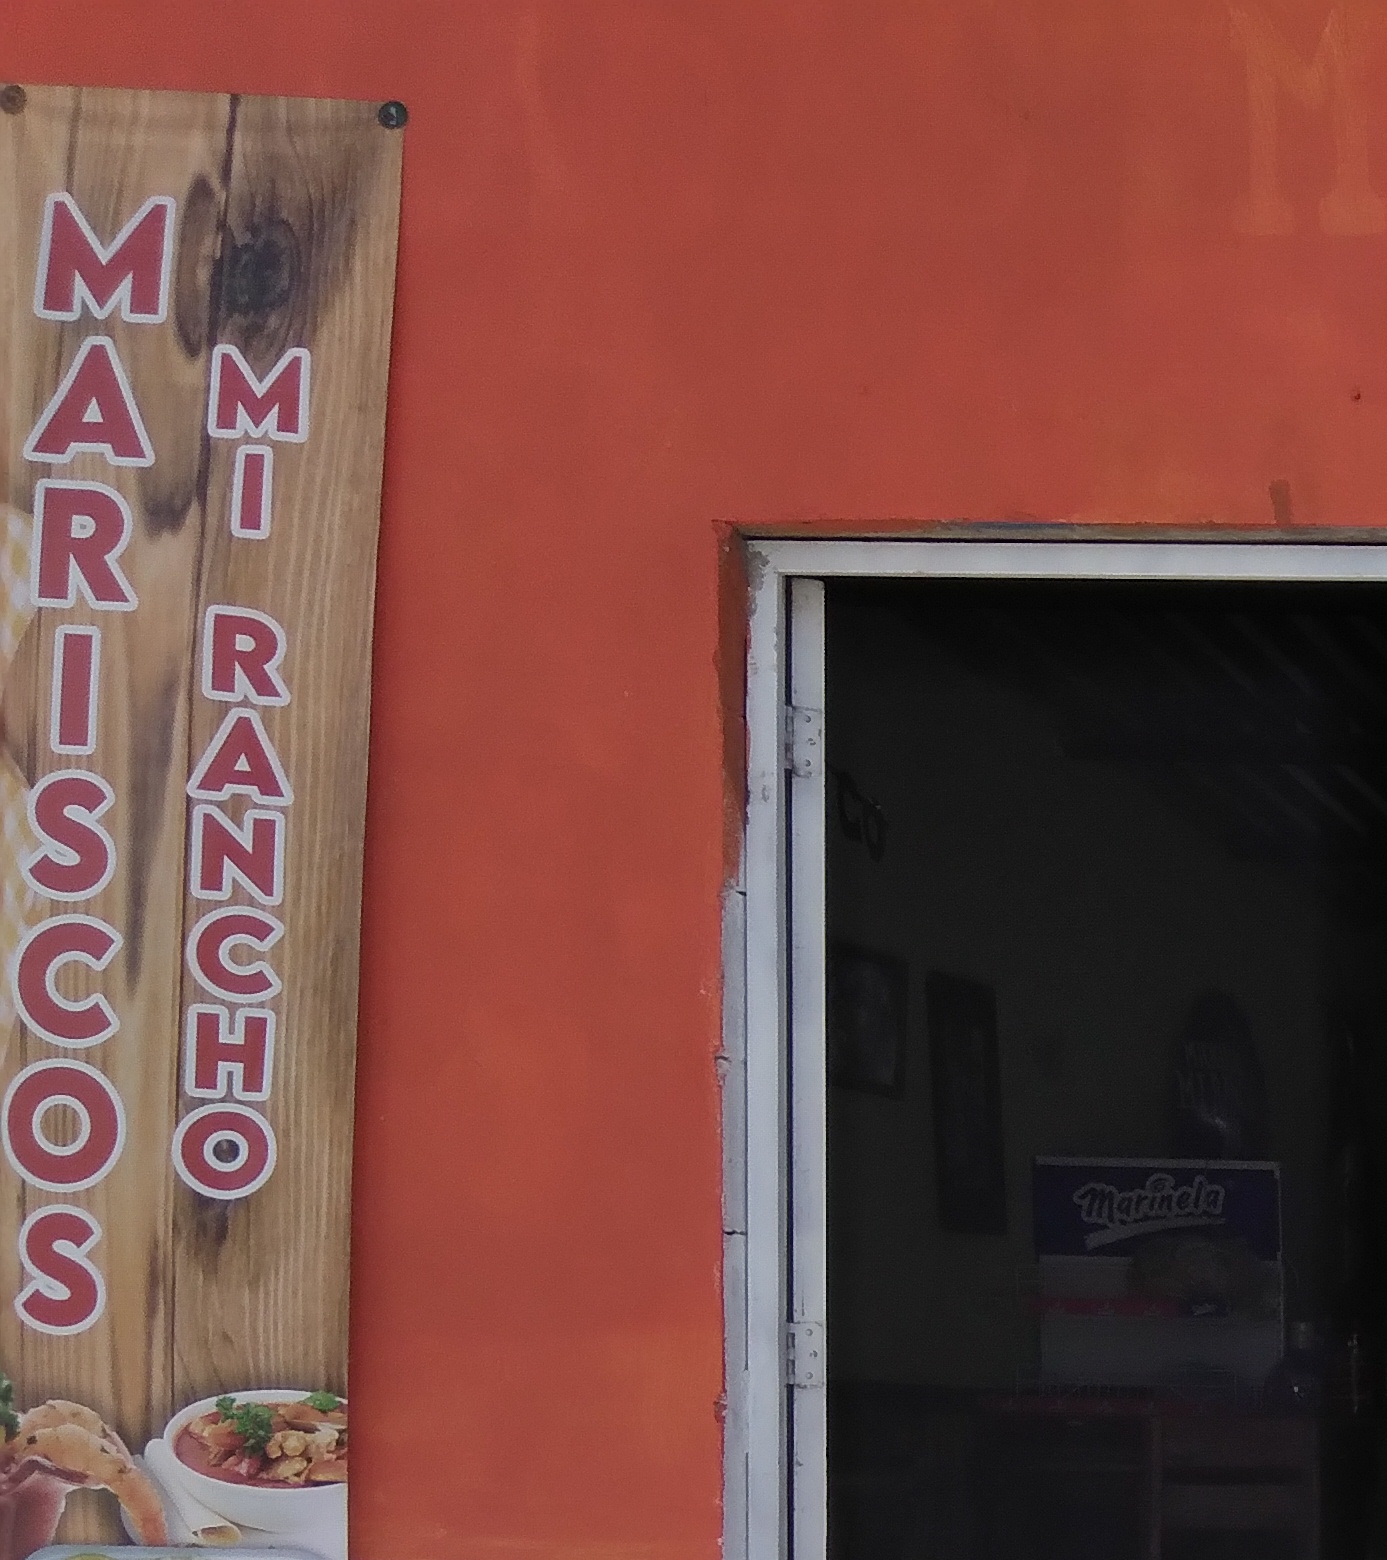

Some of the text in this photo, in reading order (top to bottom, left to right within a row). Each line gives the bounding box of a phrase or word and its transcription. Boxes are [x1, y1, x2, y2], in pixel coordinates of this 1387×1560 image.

[2, 191, 176, 1335] MARISCOS
[172, 344, 311, 1199] MI RANCHO
[1073, 1172, 1226, 1228] Marinela
